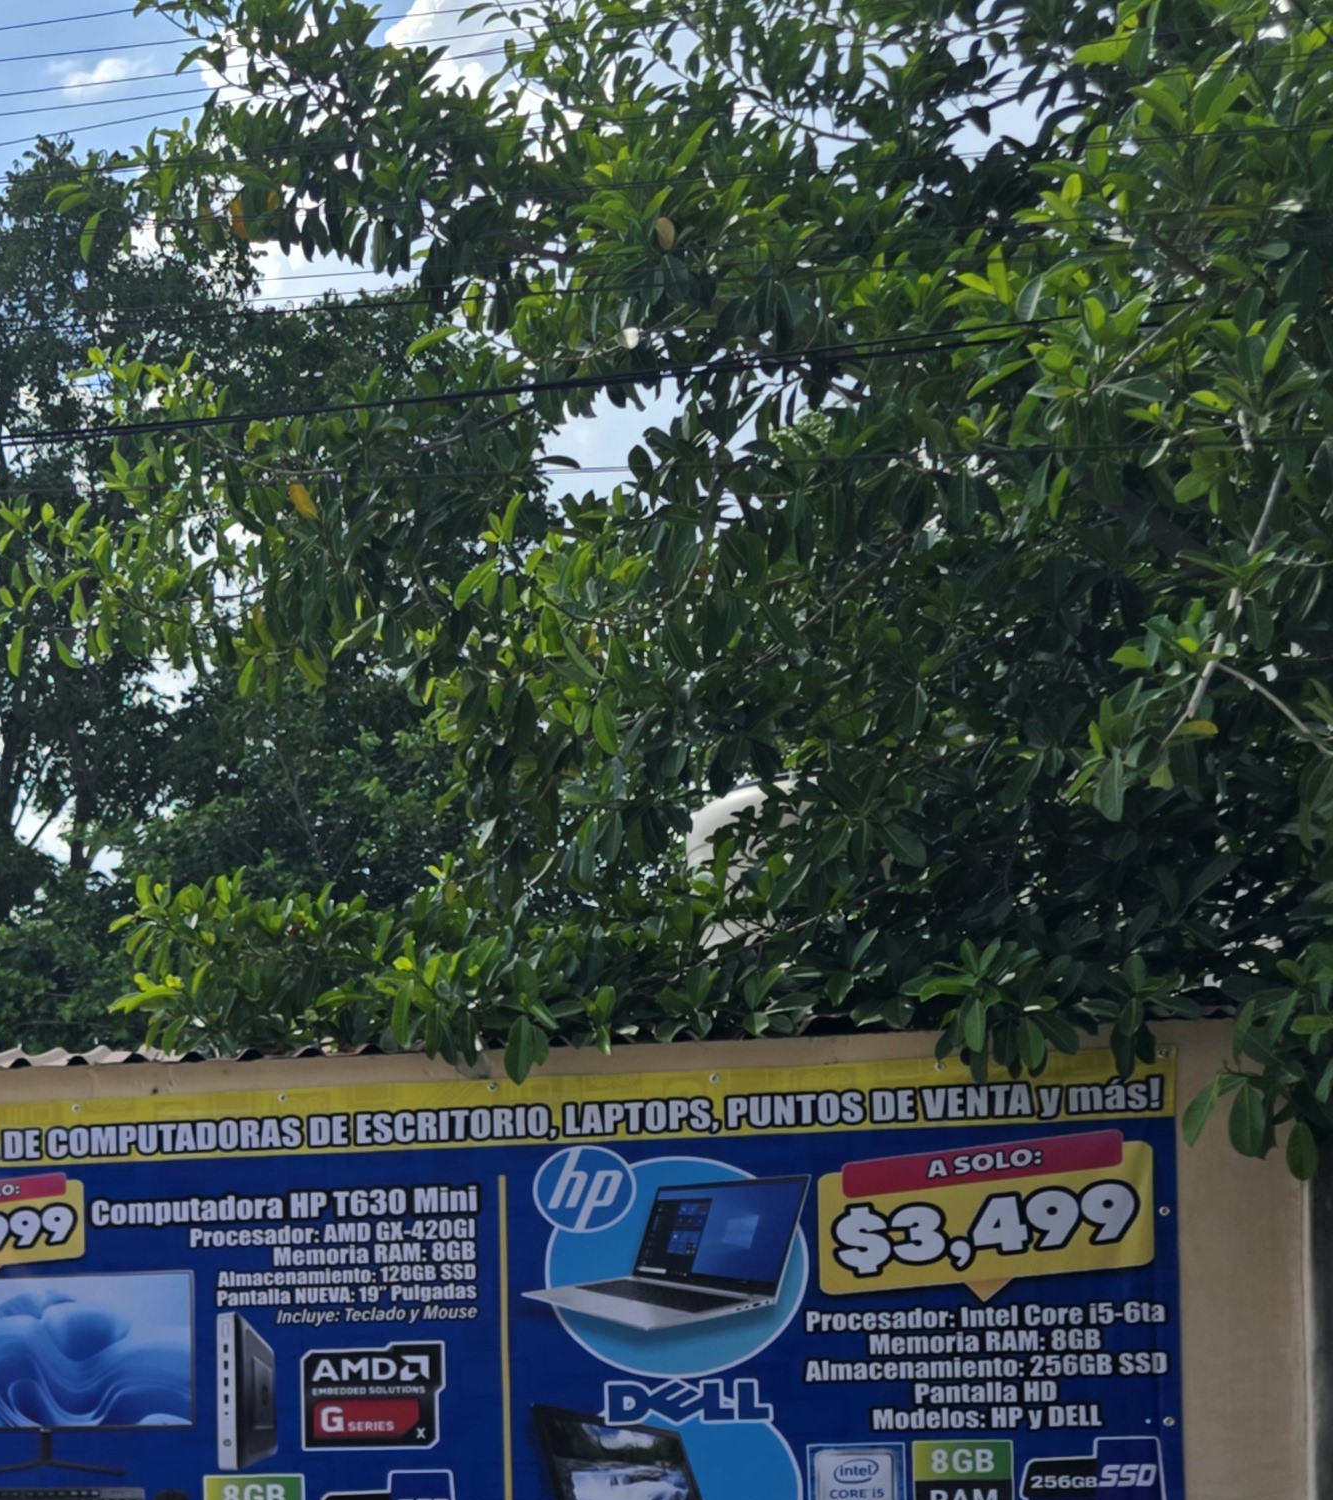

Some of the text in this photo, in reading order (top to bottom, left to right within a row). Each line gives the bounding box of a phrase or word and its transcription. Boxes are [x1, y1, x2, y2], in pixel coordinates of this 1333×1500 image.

[4, 1129, 41, 1159] DE
[47, 1116, 302, 1158] COMPUTADORAS
[309, 1115, 349, 1147] DE
[355, 1105, 557, 1144] ESCRITORIO,
[565, 1099, 720, 1136] LAPTOPS,
[727, 1090, 864, 1129] PUNTOS
[873, 1089, 915, 1122] DE
[922, 1083, 1031, 1119] VENTA
[1039, 1087, 1061, 1117] y
[1069, 1077, 1162, 1111] más!
[928, 1149, 1043, 1178] A SOLO:
[547, 1147, 623, 1230] hp
[91, 1186, 478, 1227] Computadora HP T630 Mini
[189, 1219, 476, 1248] Procesador: AMD GX-420GI
[836, 1183, 1136, 1274] $3,499
[273, 1241, 476, 1267] Memoria RAM: 8GB
[217, 1263, 477, 1288] Almacenamiento: 128GB SSD
[217, 1284, 478, 1307] Pantalla NUEVA: Pulgadas
[276, 1305, 478, 1328] Incluye: Teclado Mouse
[805, 1301, 1166, 1332] Procesador: Intel Core i5-6ta
[868, 1329, 1101, 1355] Memoria RAM: 8GB
[312, 1357, 397, 1382] AMD
[805, 1352, 1167, 1382] Almacenamiento: 256GB SSD
[312, 1385, 426, 1396] EMBEDDED SOLUTIONS
[604, 1377, 774, 1426] DELL
[915, 1380, 1058, 1404] Pantalla HD
[320, 1406, 395, 1432] G SERIES
[873, 1405, 1102, 1431] Modelos: HP y DELL
[839, 1463, 874, 1478] intel
[931, 1448, 995, 1474] 8GB
[1030, 1464, 1157, 1489] 256GB SSD
[829, 1489, 867, 1499] CORE
